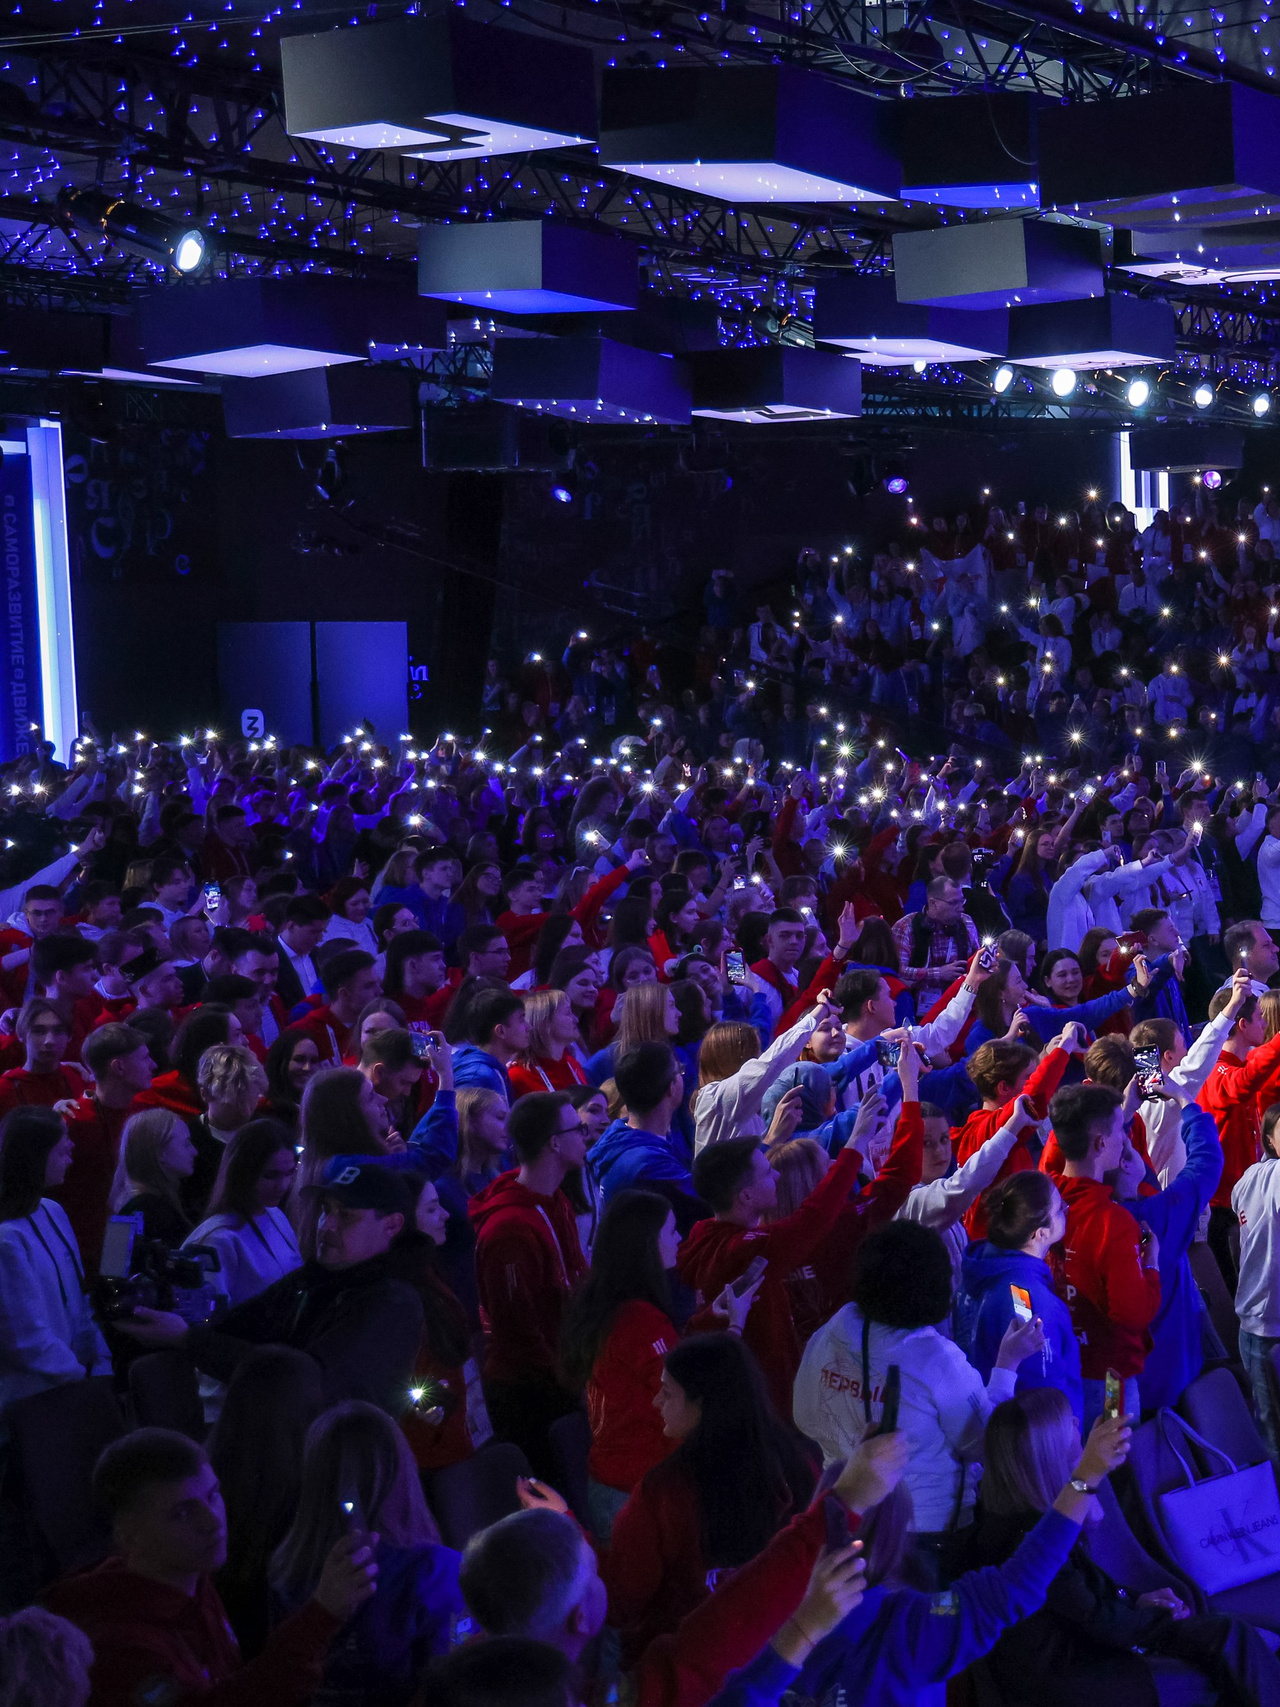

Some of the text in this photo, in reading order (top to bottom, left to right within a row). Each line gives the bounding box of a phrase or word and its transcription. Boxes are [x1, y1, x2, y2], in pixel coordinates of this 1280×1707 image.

[4, 513, 25, 667] САМОРАЗВИТИЕ
[821, 1370, 886, 1403] ПЕРВЫ
[1199, 1533, 1229, 1549] CALVIN
[1251, 1514, 1279, 1533] JEANS
